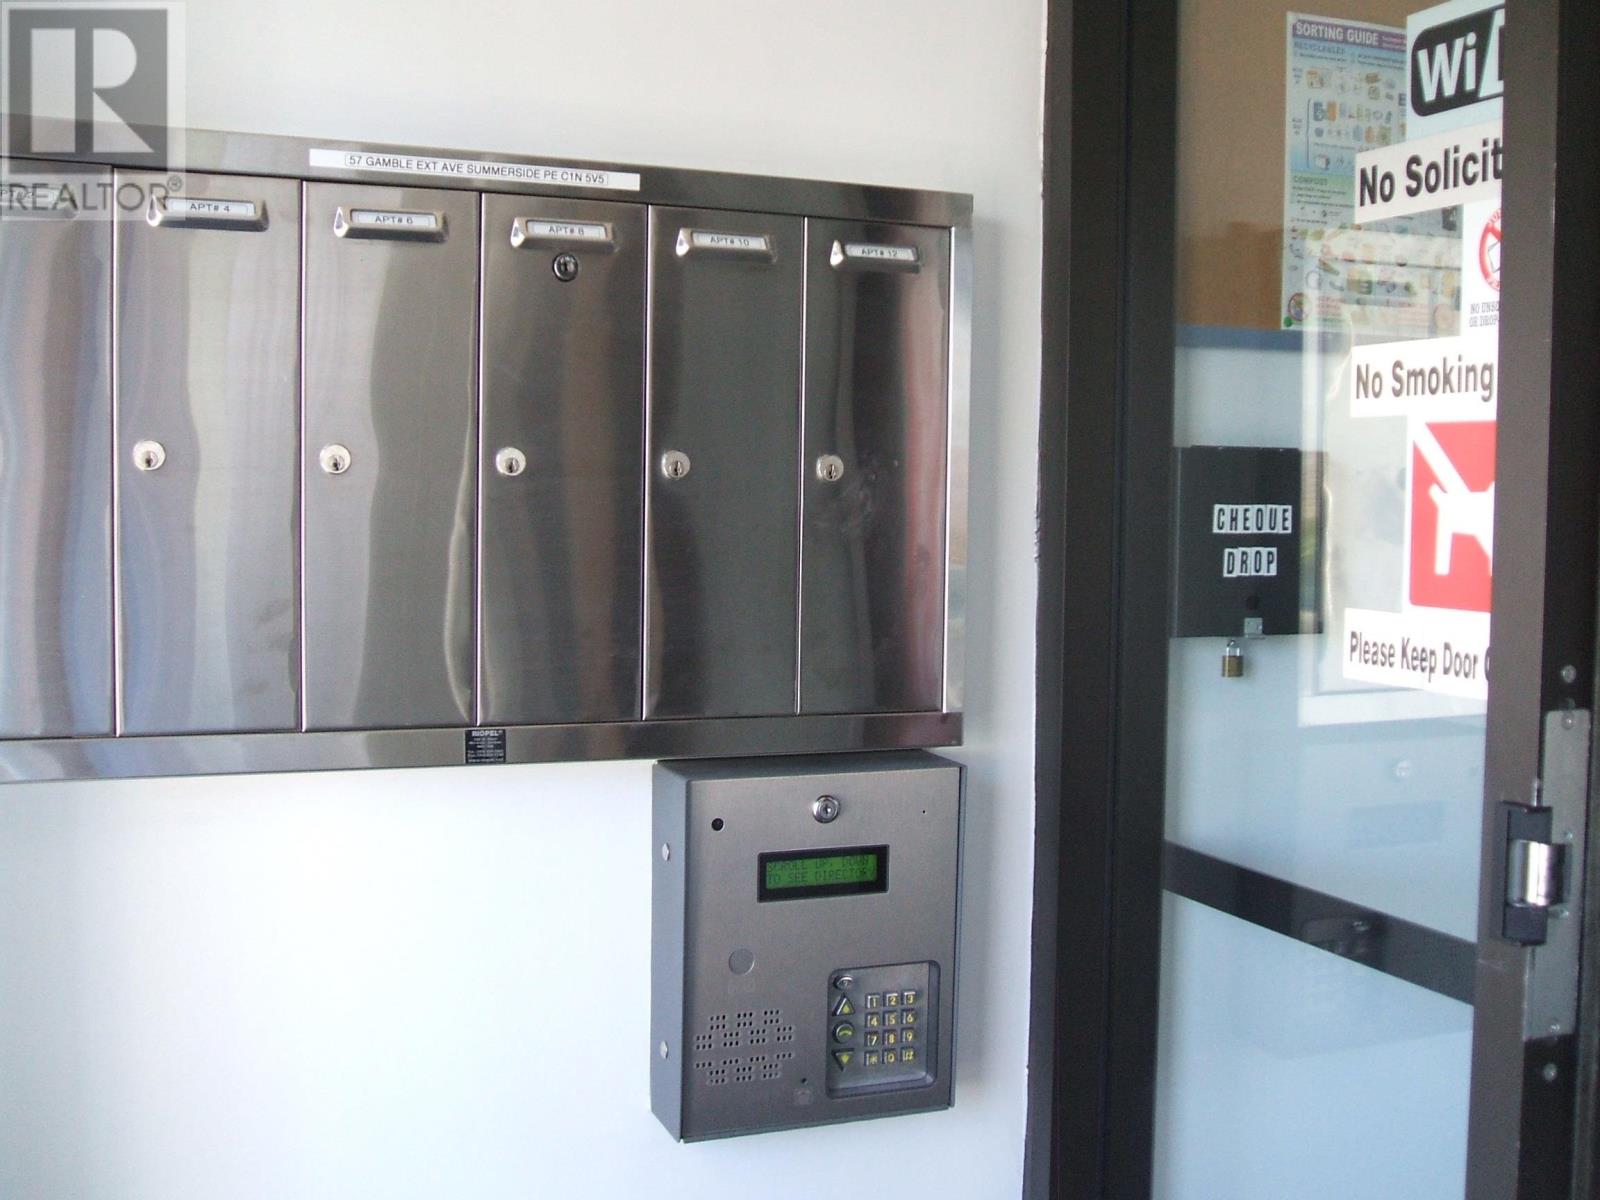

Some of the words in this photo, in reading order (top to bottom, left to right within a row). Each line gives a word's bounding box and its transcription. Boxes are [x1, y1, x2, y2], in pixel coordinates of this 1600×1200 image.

[1296, 22, 1344, 40] SORTING
[1346, 29, 1379, 46] GUIDE
[1417, 31, 1504, 102] Wi
[349, 156, 362, 165] 57
[366, 157, 412, 169] GAMBLE
[416, 160, 438, 170] EXT
[441, 162, 464, 173] AVE
[466, 164, 540, 179] SUMMERSIDE
[543, 170, 557, 179] PE
[585, 174, 605, 183] 5V5
[1360, 164, 1395, 207] No
[190, 202, 222, 211] APT#
[1356, 363, 1383, 400] No
[1392, 355, 1494, 402] Smoking
[1226, 550, 1275, 575] DROP
[1350, 631, 1396, 668] Please
[1401, 636, 1437, 683] Keep
[1443, 642, 1478, 680] Door
